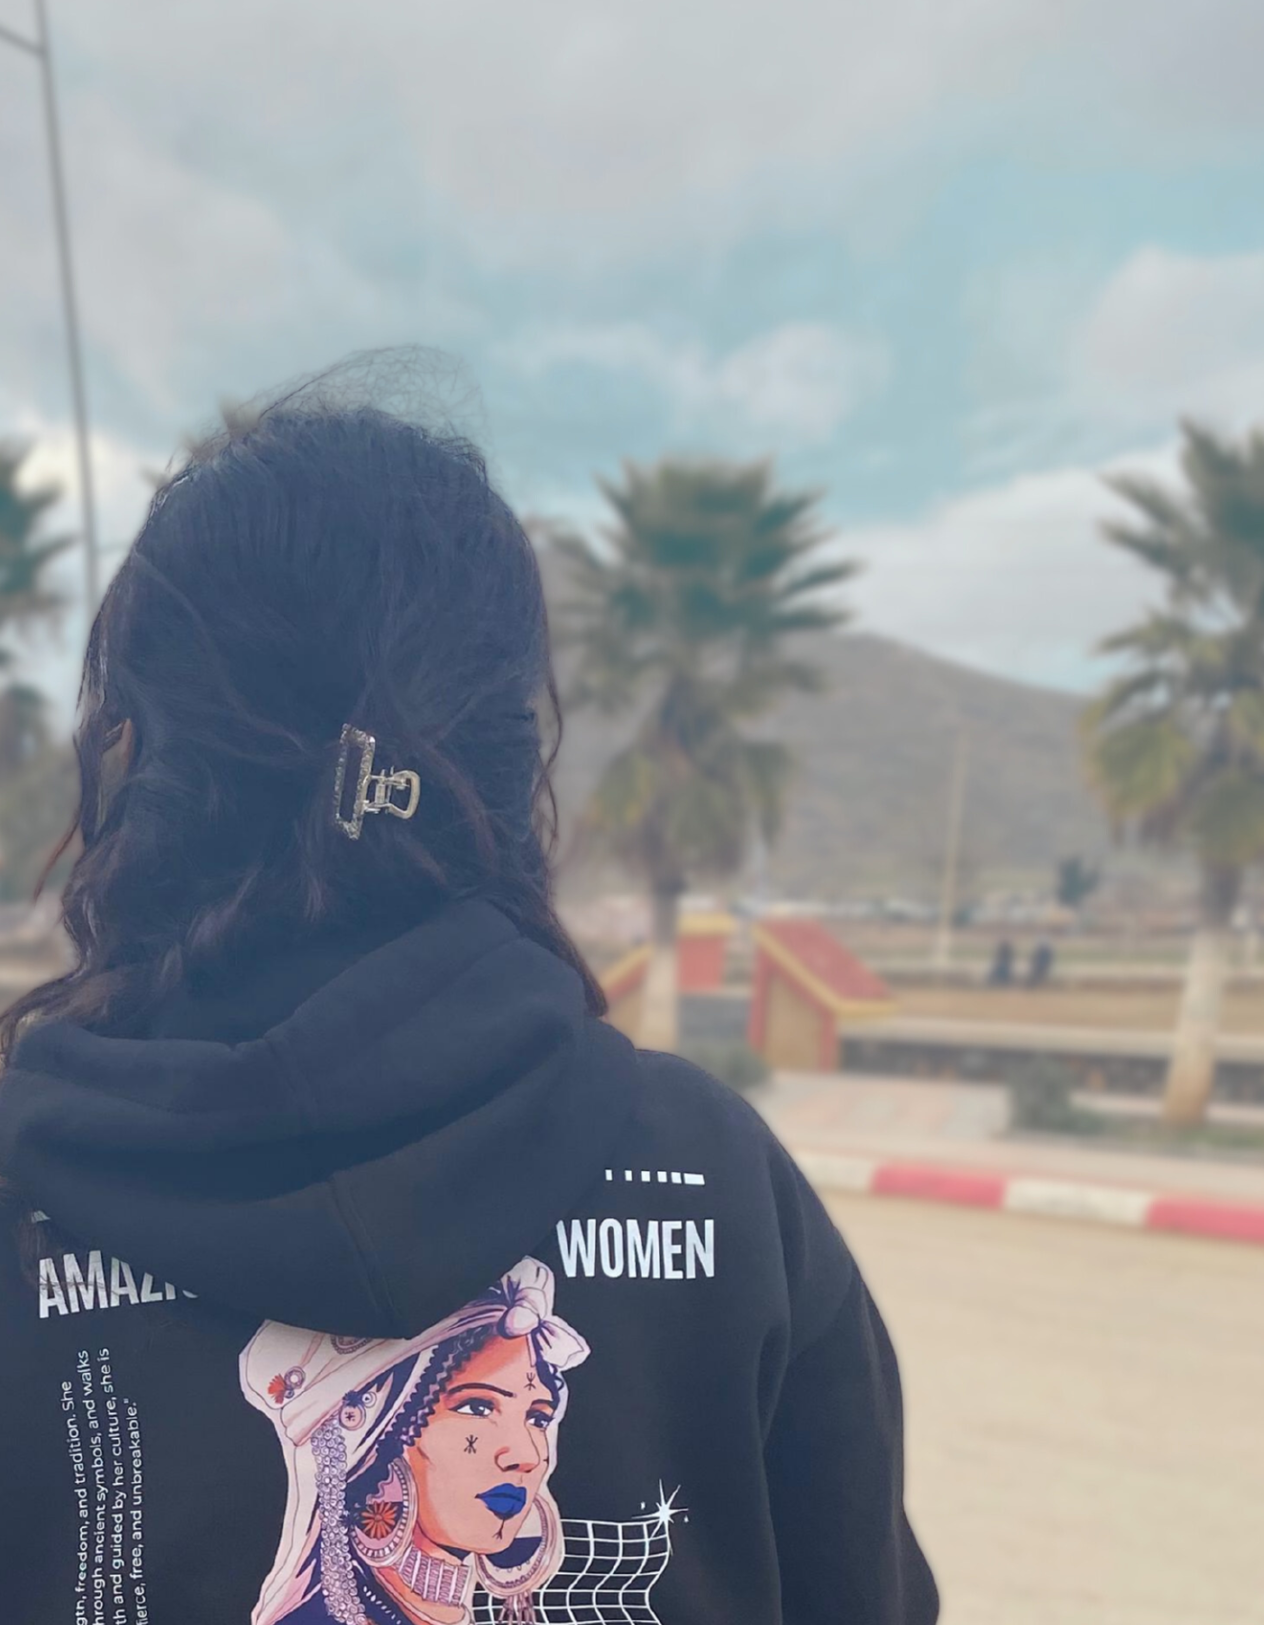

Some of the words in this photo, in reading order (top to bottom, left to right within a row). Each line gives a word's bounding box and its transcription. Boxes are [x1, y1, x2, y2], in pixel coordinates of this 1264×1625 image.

[556, 1218, 715, 1279] WOMEN
[96, 1348, 110, 1362] is
[76, 1350, 93, 1396] walks
[100, 1364, 114, 1393] she
[60, 1381, 74, 1411] She
[82, 1400, 98, 1428] and
[106, 1396, 122, 1456] culture,
[66, 1414, 86, 1484] tradition.
[89, 1432, 108, 1502] symbols,
[112, 1460, 124, 1486] her
[74, 1488, 88, 1518] and
[112, 1490, 126, 1510] by
[93, 1504, 106, 1564] ancient
[110, 1513, 124, 1570] guided
[130, 1510, 142, 1540] and
[75, 1521, 90, 1592] freedom,
[129, 1544, 144, 1580] free,
[110, 1574, 124, 1604] and
